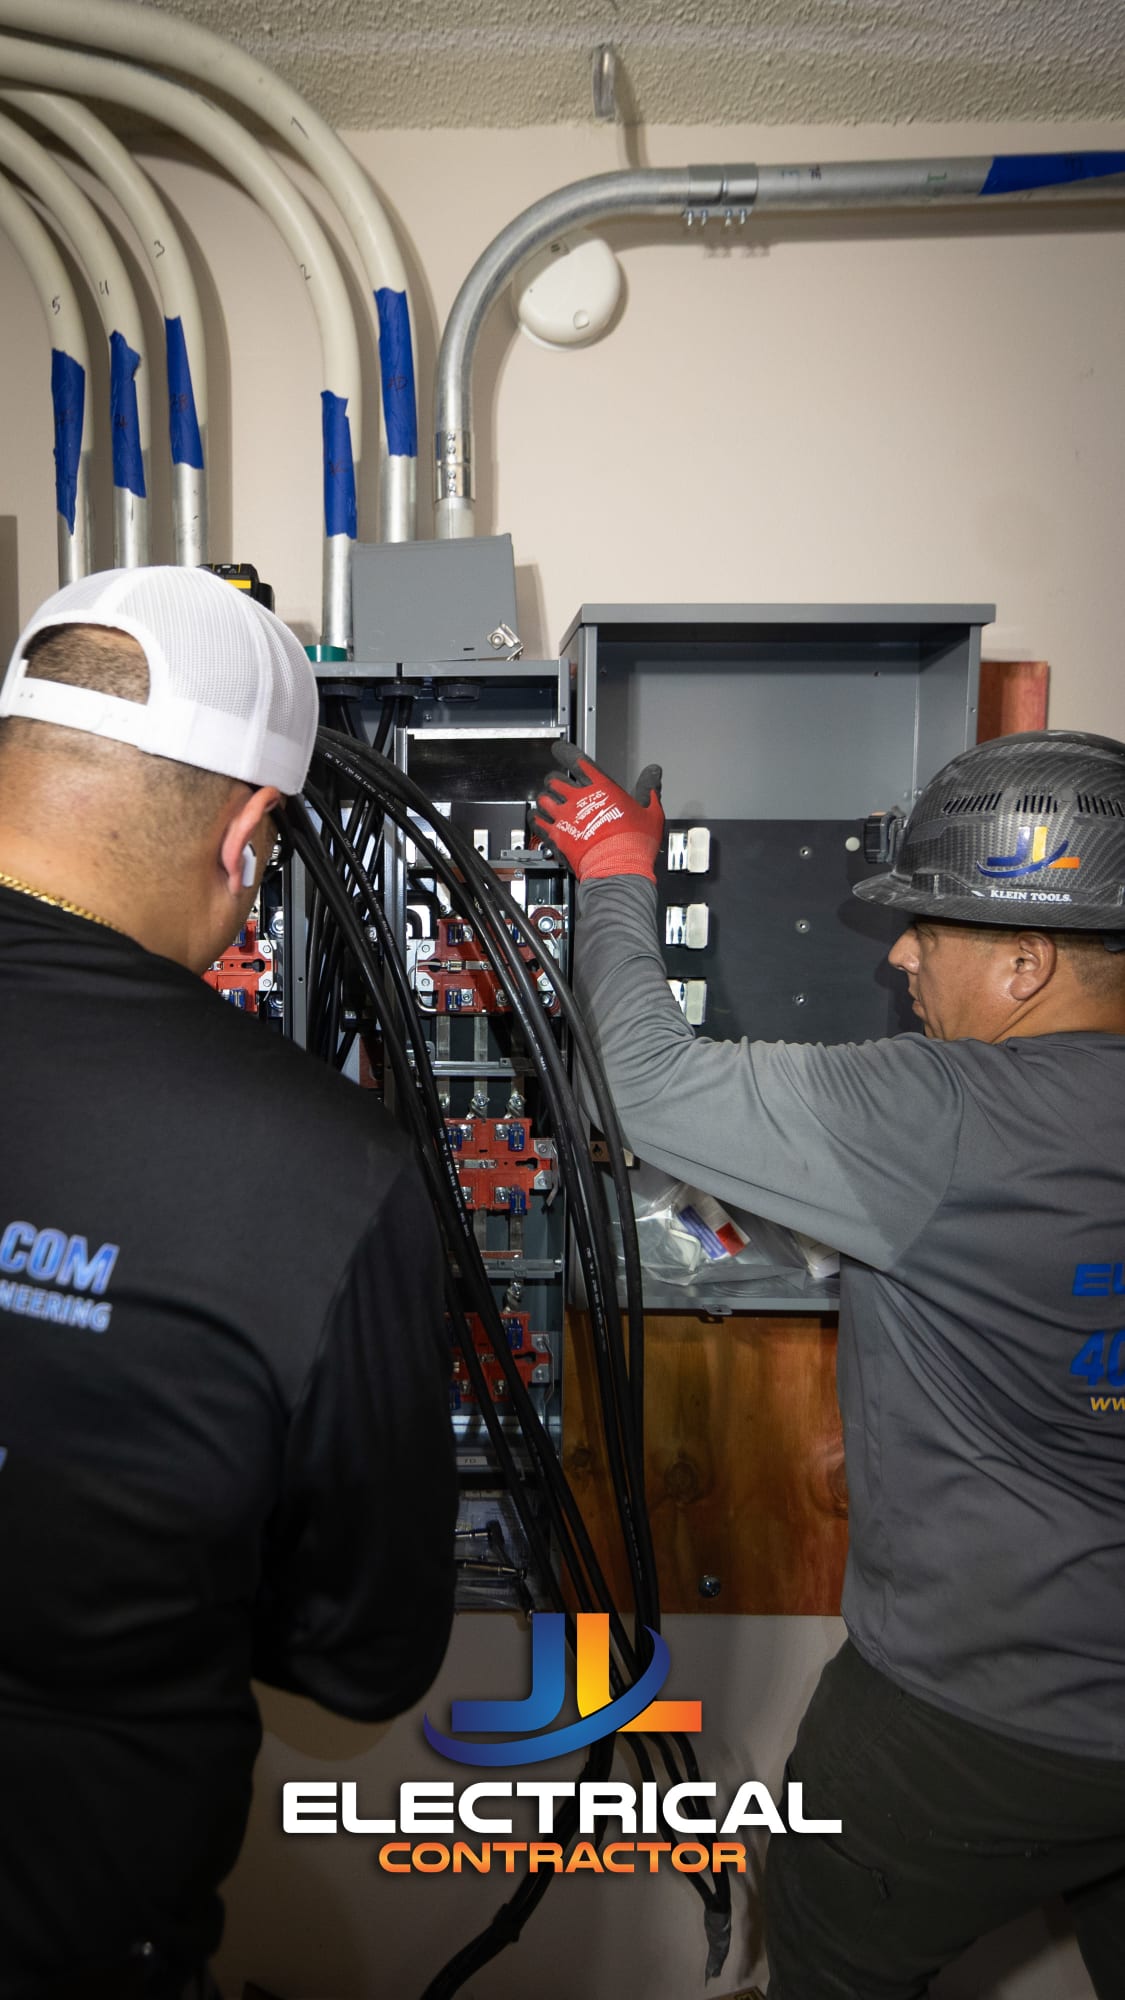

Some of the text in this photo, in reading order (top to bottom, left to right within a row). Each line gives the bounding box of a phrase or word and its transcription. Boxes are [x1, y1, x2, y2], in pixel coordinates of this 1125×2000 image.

[153, 239, 166, 259] 3
[299, 262, 312, 282] 2
[51, 295, 61, 315] 5
[990, 889, 1027, 901] KLEIN
[0, 1221, 120, 1295] COM
